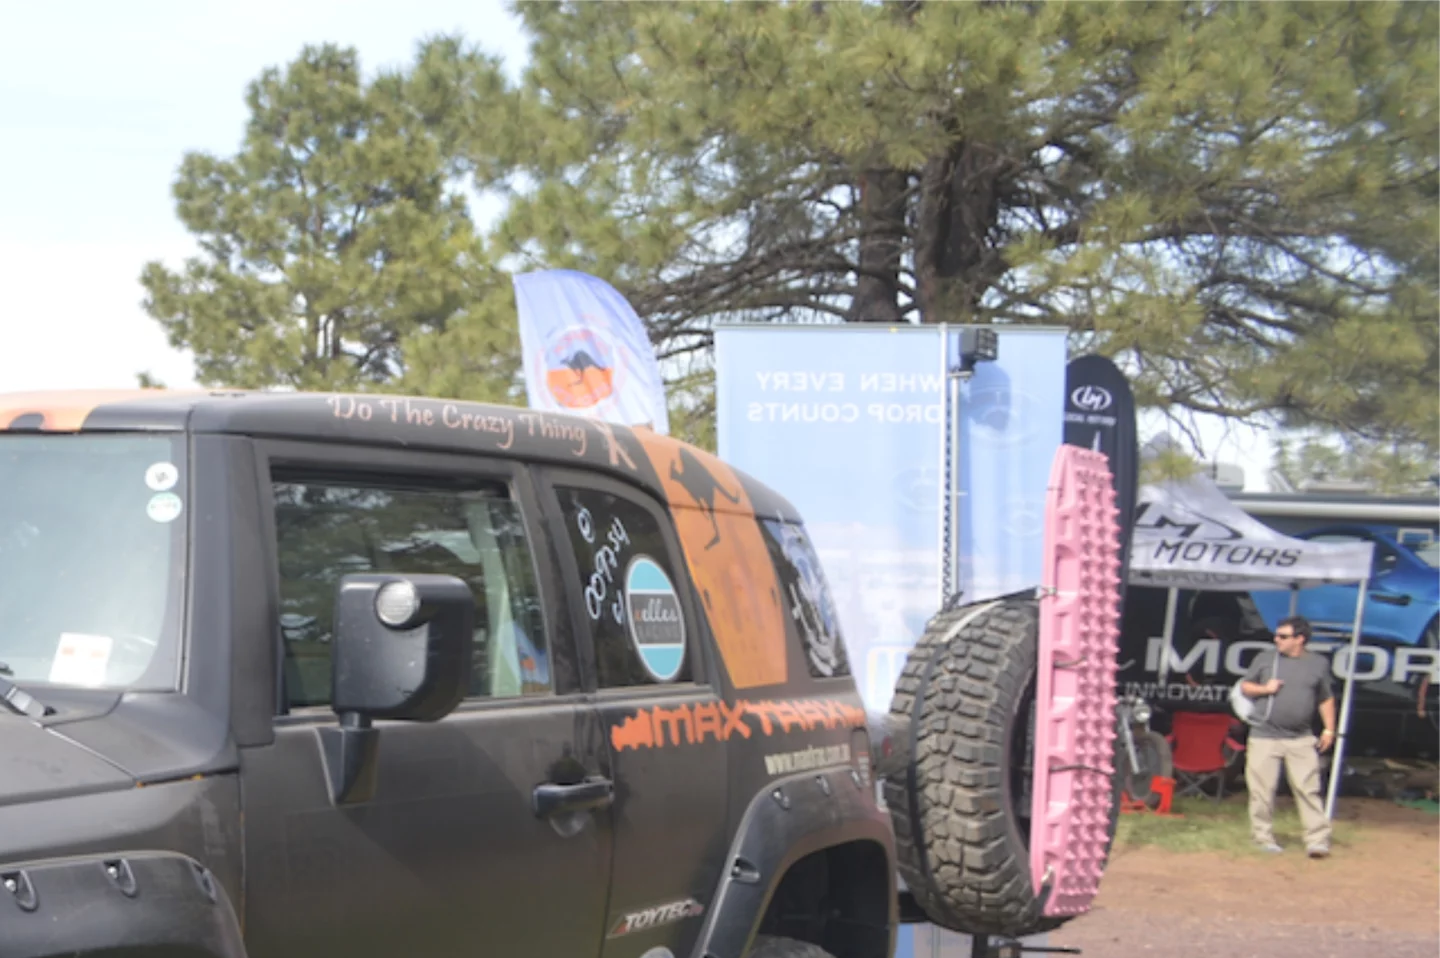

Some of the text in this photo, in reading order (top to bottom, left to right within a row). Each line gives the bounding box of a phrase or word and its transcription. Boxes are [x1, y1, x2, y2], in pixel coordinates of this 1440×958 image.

[327, 395, 586, 456] Do The Crazy Thing
[1154, 539, 1303, 568] MOTORS
[1143, 636, 1440, 684] MOOR
